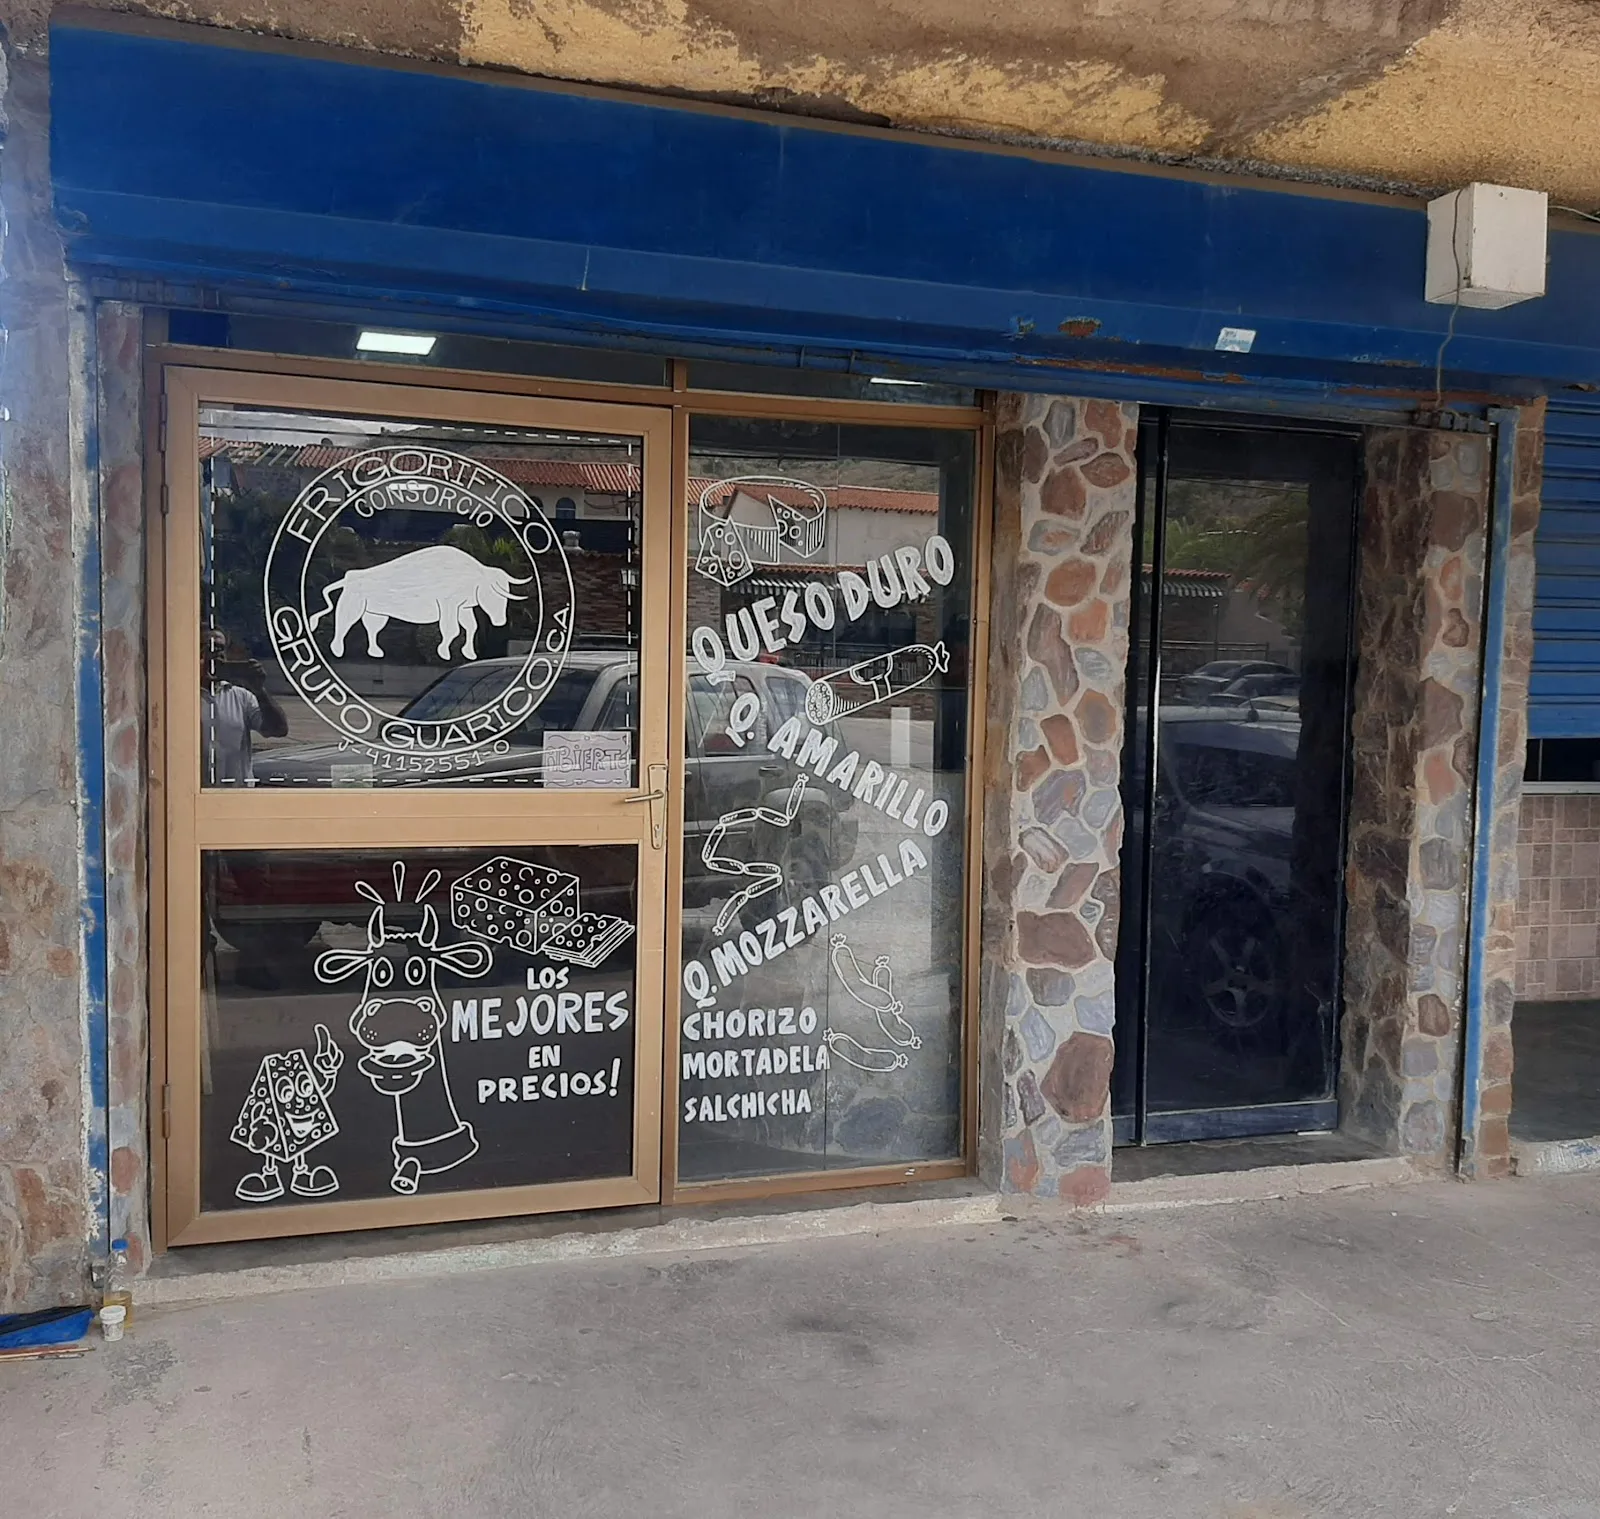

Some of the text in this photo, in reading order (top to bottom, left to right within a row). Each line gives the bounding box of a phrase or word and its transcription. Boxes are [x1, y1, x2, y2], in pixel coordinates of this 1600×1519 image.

[286, 450, 552, 555] FRIGORIFICO
[354, 480, 495, 528] CONSORCIO
[692, 535, 954, 686] QUESO DURO
[273, 606, 372, 734] GRUPO
[725, 692, 949, 837] Q. AMARILLO
[710, 838, 928, 987] MOZZARELLA
[527, 966, 570, 991] LOS
[451, 990, 629, 1043] MEJORES
[682, 1006, 818, 1041] CHORIZO
[477, 1058, 621, 1104] PRECIOS!
[528, 1045, 561, 1069] EN
[682, 1045, 831, 1080] MORTADELA
[684, 1089, 812, 1123] SALCHICHA
